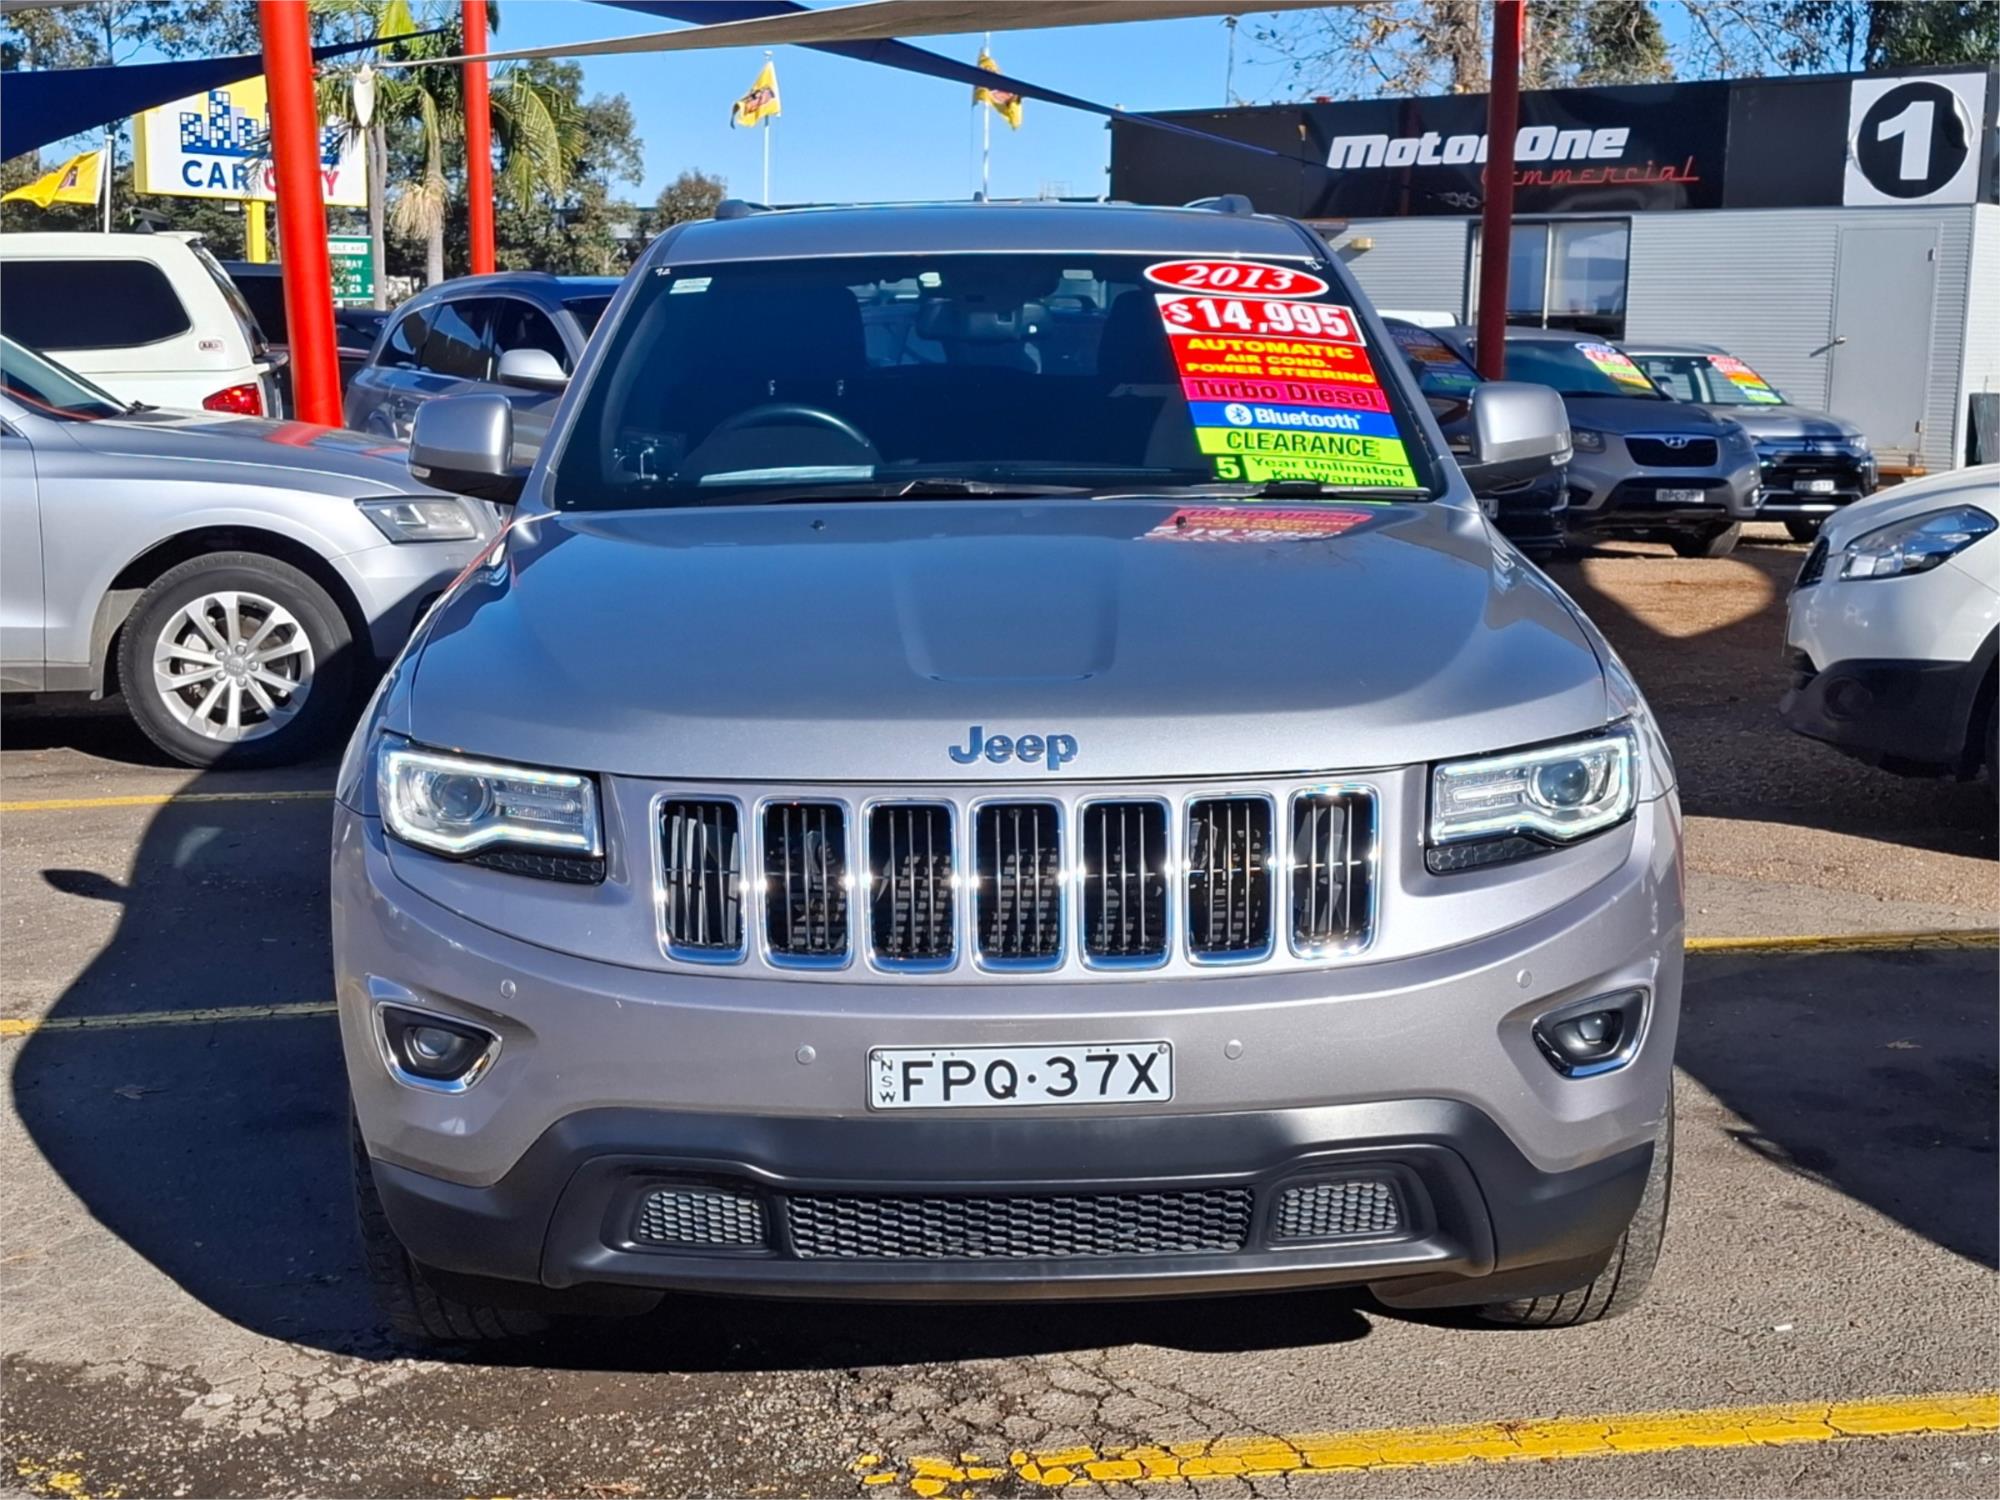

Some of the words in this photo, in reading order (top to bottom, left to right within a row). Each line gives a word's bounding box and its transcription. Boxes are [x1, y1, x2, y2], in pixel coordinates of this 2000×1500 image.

[1877, 101, 1935, 180] 1
[181, 160, 250, 190] CAR
[1481, 156, 1699, 186] mmercial
[1177, 265, 1296, 291] 2013
[1166, 299, 1350, 337] $14,995
[1187, 338, 1356, 359] AUTOMATIC
[1224, 353, 1261, 364] AIR
[1266, 355, 1332, 369] COND.
[1185, 362, 1263, 376] POWER
[1268, 366, 1375, 384] STEERING
[1194, 380, 1278, 400] Turbo
[1287, 383, 1381, 407] Diesel
[1226, 431, 1377, 457] CLEARANCE
[1216, 456, 1241, 479] 5
[1252, 456, 1297, 469] Year
[1305, 459, 1405, 478] Unlimited
[949, 726, 1078, 771] Jeep
